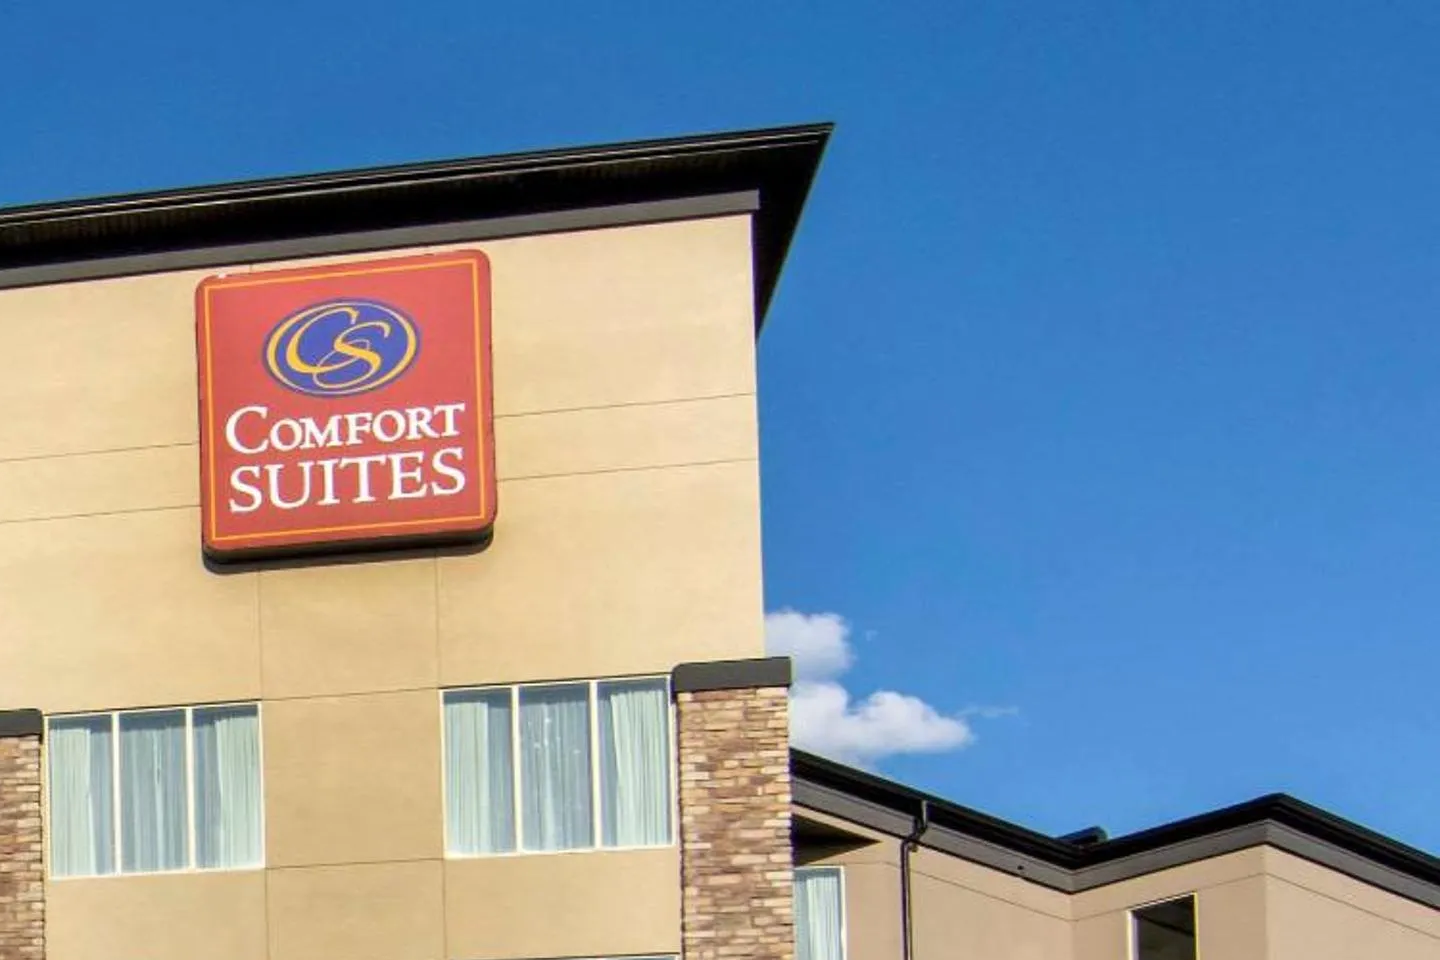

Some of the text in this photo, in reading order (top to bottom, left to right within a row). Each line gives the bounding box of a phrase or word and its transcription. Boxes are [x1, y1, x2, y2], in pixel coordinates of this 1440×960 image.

[286, 306, 391, 388] CS
[225, 404, 466, 454] COMFORT
[229, 447, 466, 513] SUITES
